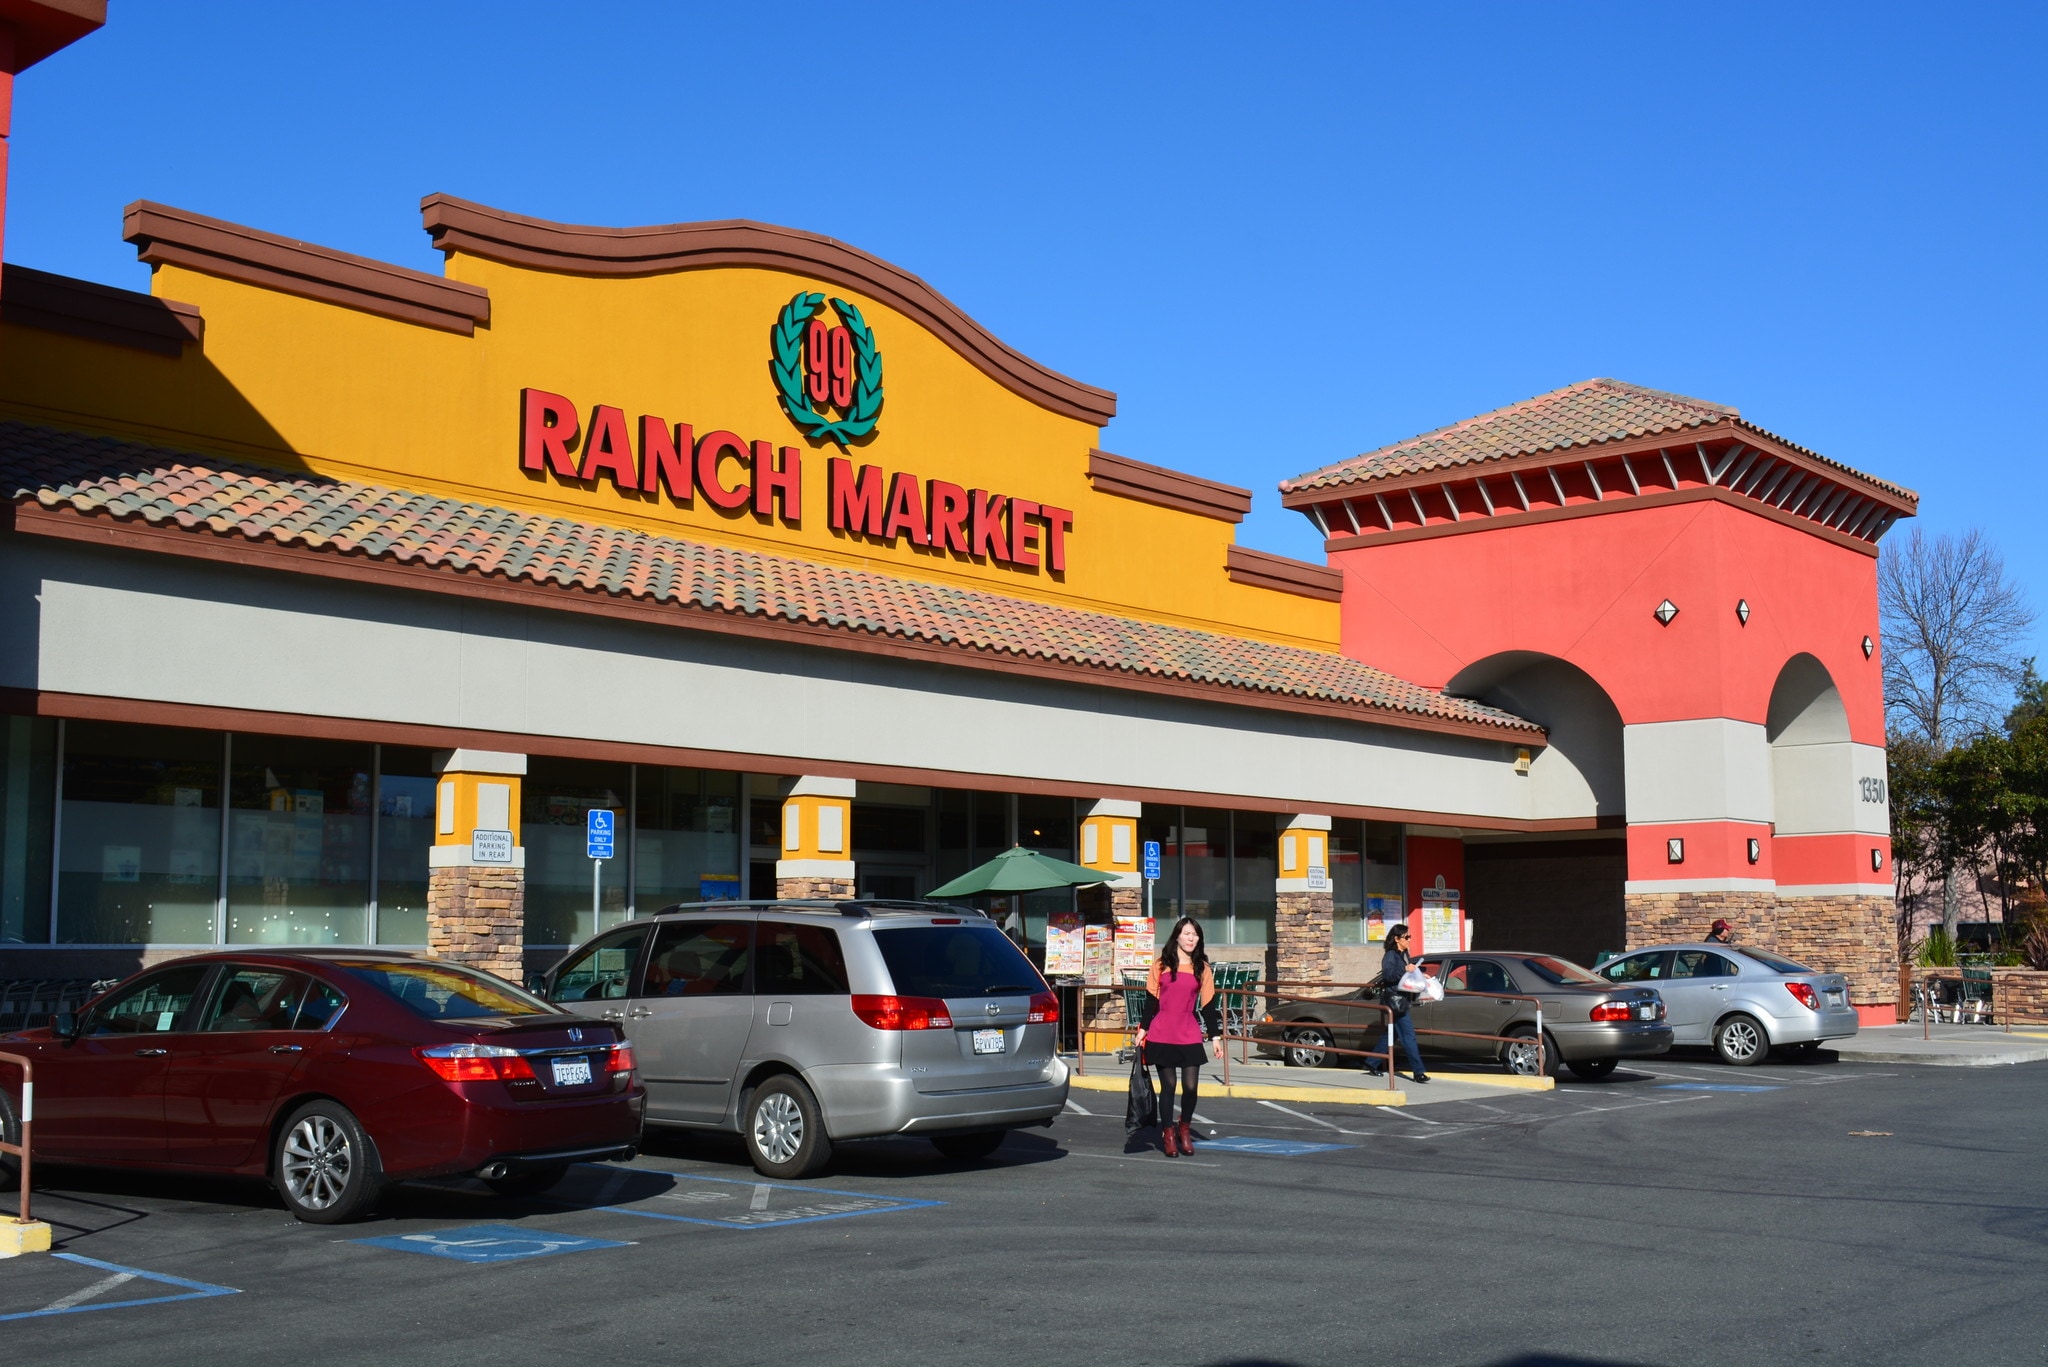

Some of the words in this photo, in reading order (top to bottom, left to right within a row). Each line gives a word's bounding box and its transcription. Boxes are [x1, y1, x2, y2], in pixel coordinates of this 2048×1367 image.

[805, 319, 852, 408] 99
[520, 387, 801, 521] RANCH
[827, 457, 1074, 573] MARKET
[1858, 776, 1886, 804] 1350
[475, 833, 509, 842] ADDITIONAL
[590, 828, 612, 836] PARKING
[479, 842, 506, 850] PARKING
[489, 851, 506, 859] REAR
[555, 1066, 589, 1082] 7EPF656
